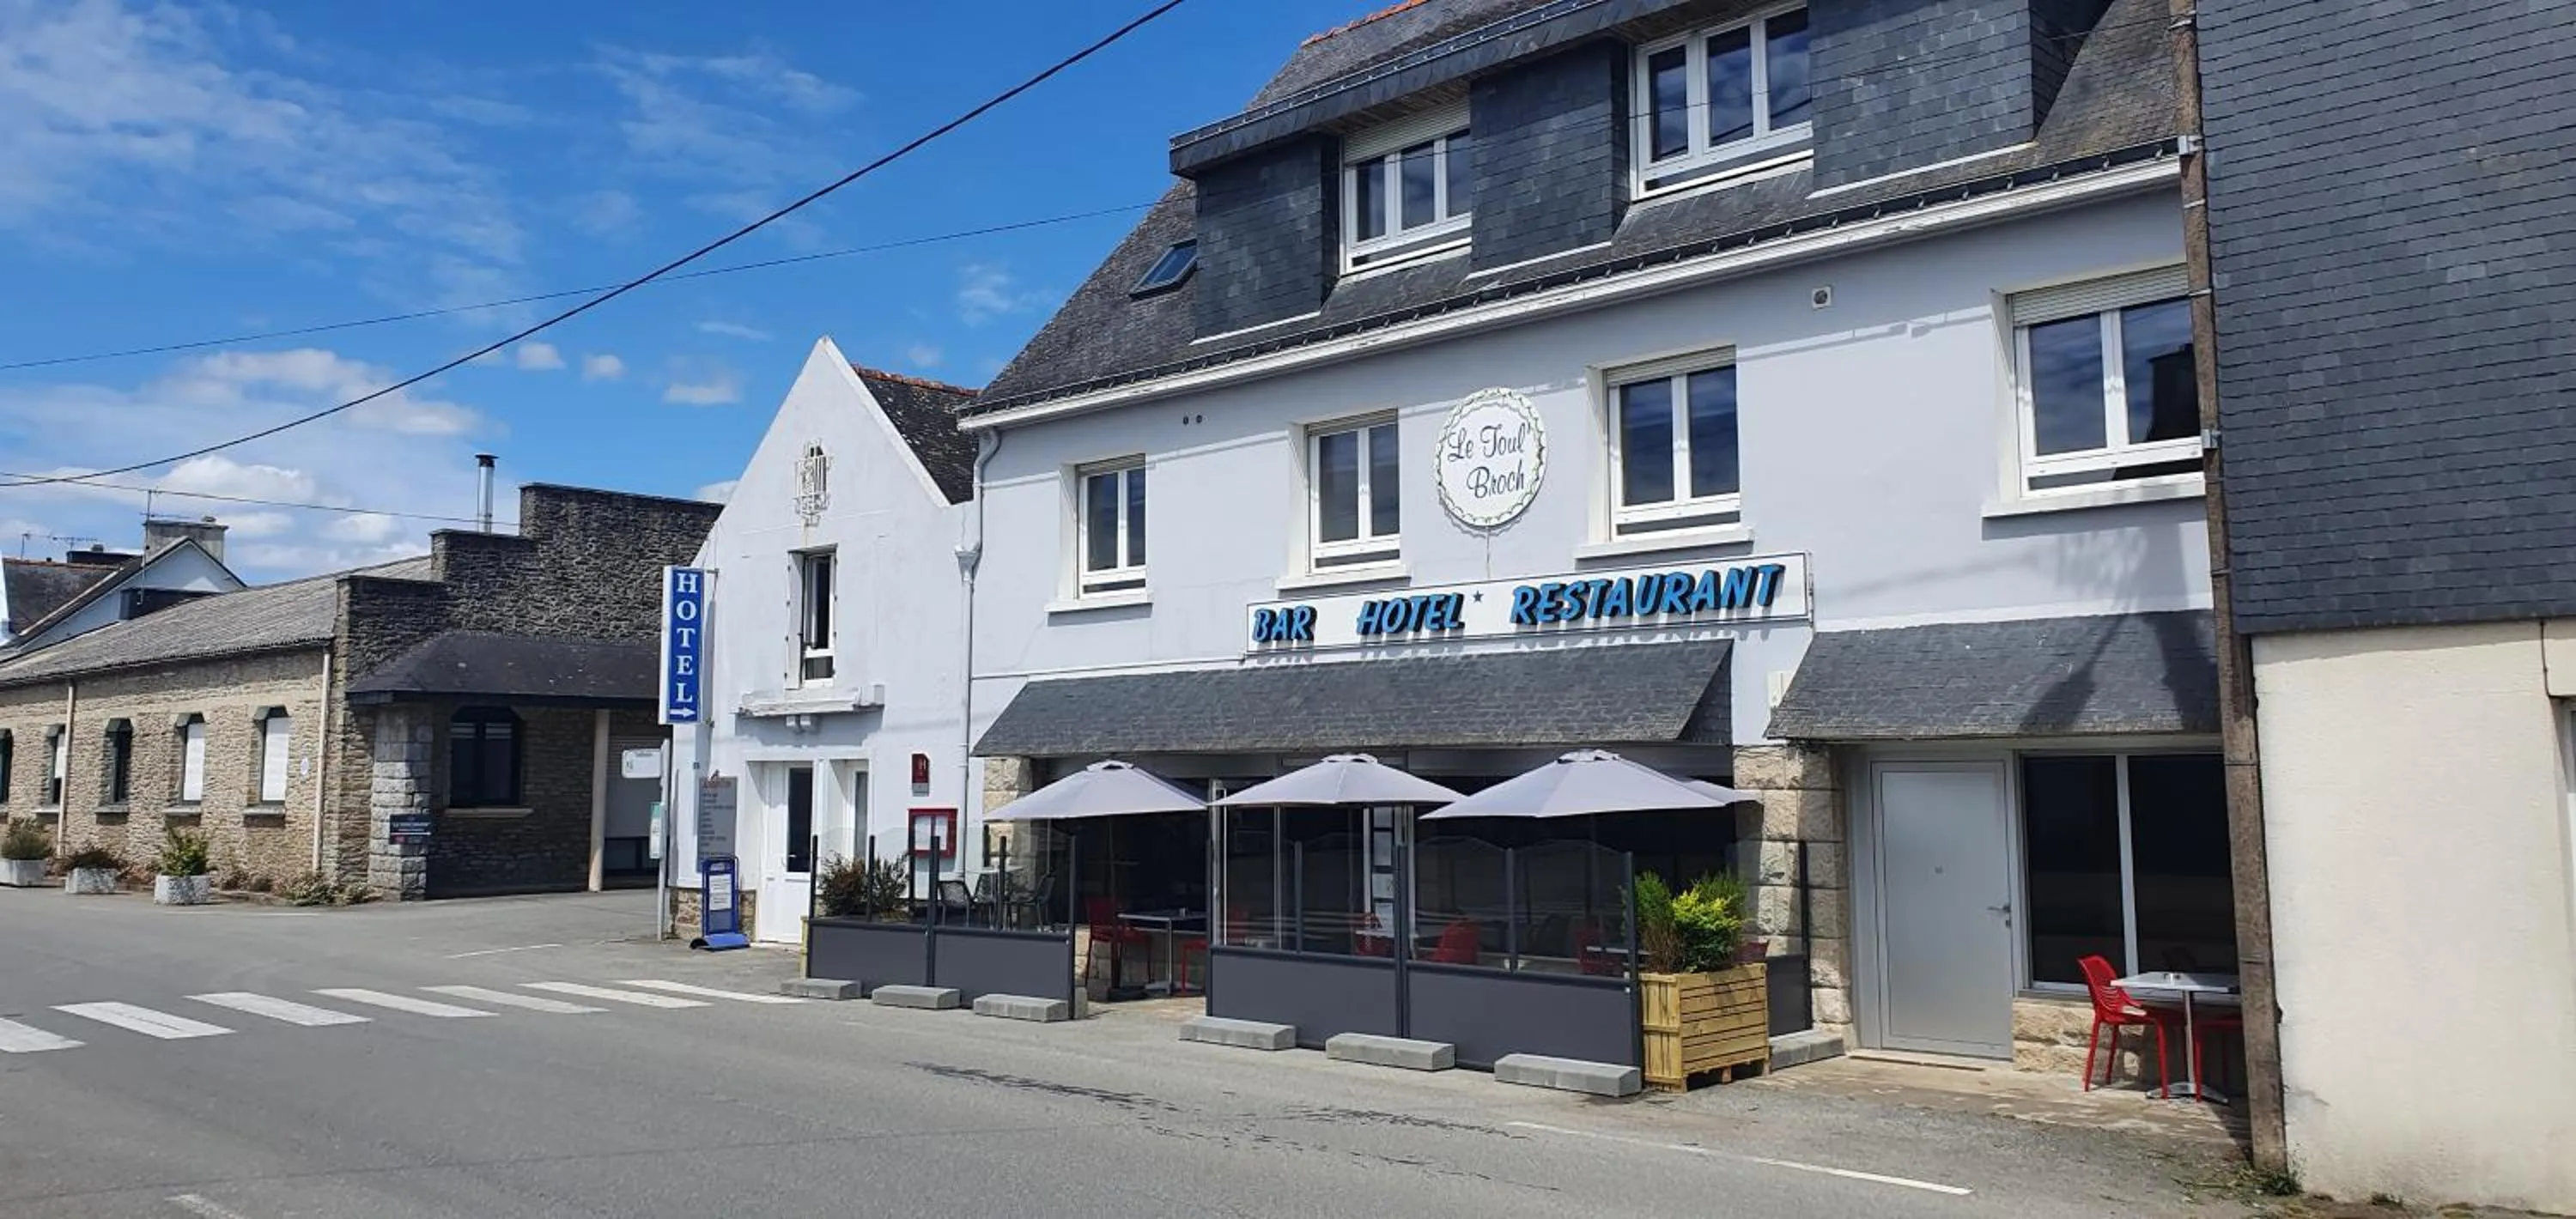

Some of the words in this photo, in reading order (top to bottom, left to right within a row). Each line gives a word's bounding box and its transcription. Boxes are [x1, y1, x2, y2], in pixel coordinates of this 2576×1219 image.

[1447, 427, 1474, 463] Le
[1479, 421, 1531, 458] Toul'
[1466, 458, 1525, 499] Broch
[1252, 604, 1317, 643] BAR
[1356, 592, 1465, 636] HOTEL
[1510, 564, 1786, 626] RESTAURANT
[676, 572, 699, 704] HOTEL
